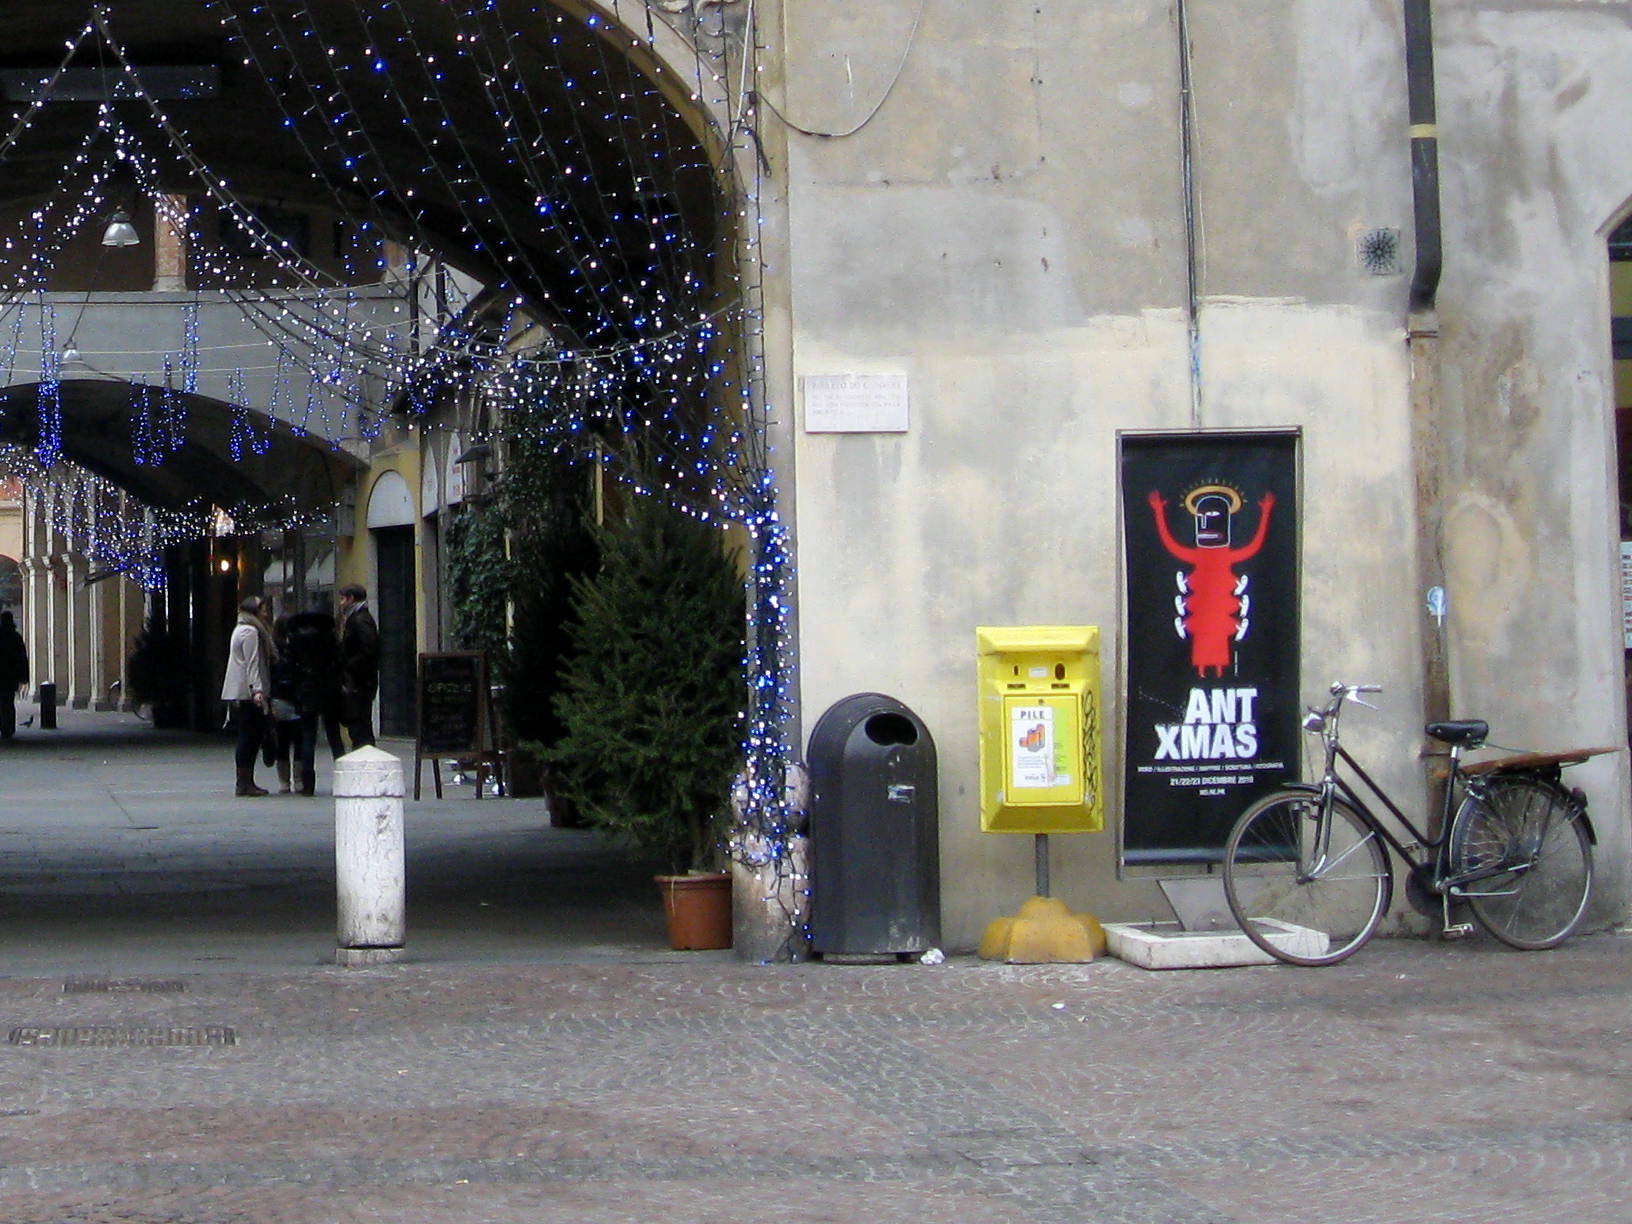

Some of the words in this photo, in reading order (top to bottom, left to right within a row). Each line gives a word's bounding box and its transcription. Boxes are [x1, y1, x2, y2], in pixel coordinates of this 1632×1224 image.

[1020, 710, 1045, 719] PILE
[1183, 687, 1258, 724] ANT
[1154, 723, 1258, 760] XMAS
[1202, 776, 1237, 785] DICEMBRE
